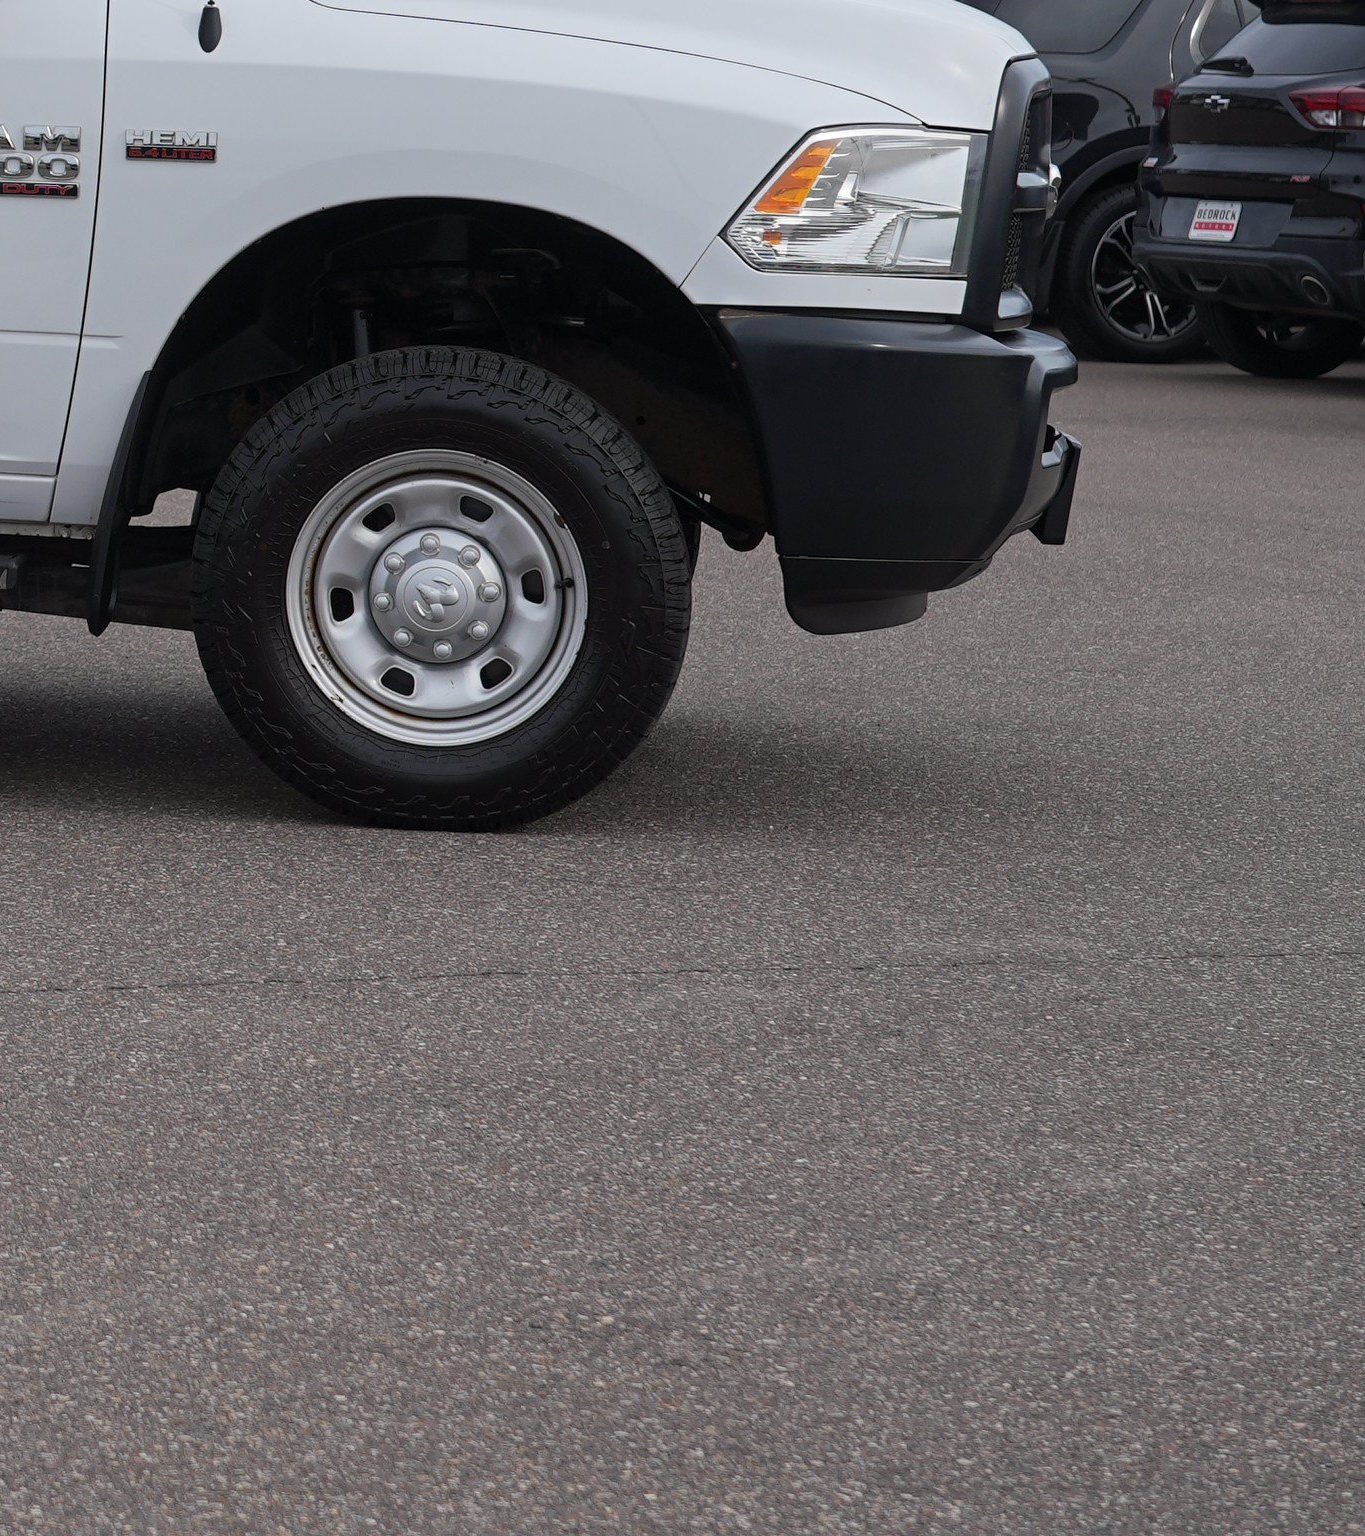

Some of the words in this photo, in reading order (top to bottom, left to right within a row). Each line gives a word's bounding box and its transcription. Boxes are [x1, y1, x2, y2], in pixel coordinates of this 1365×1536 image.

[125, 129, 218, 147] HEMI
[161, 148, 214, 160] LITER
[2, 183, 73, 196] DUTY
[1197, 208, 1237, 221] BEDROCK
